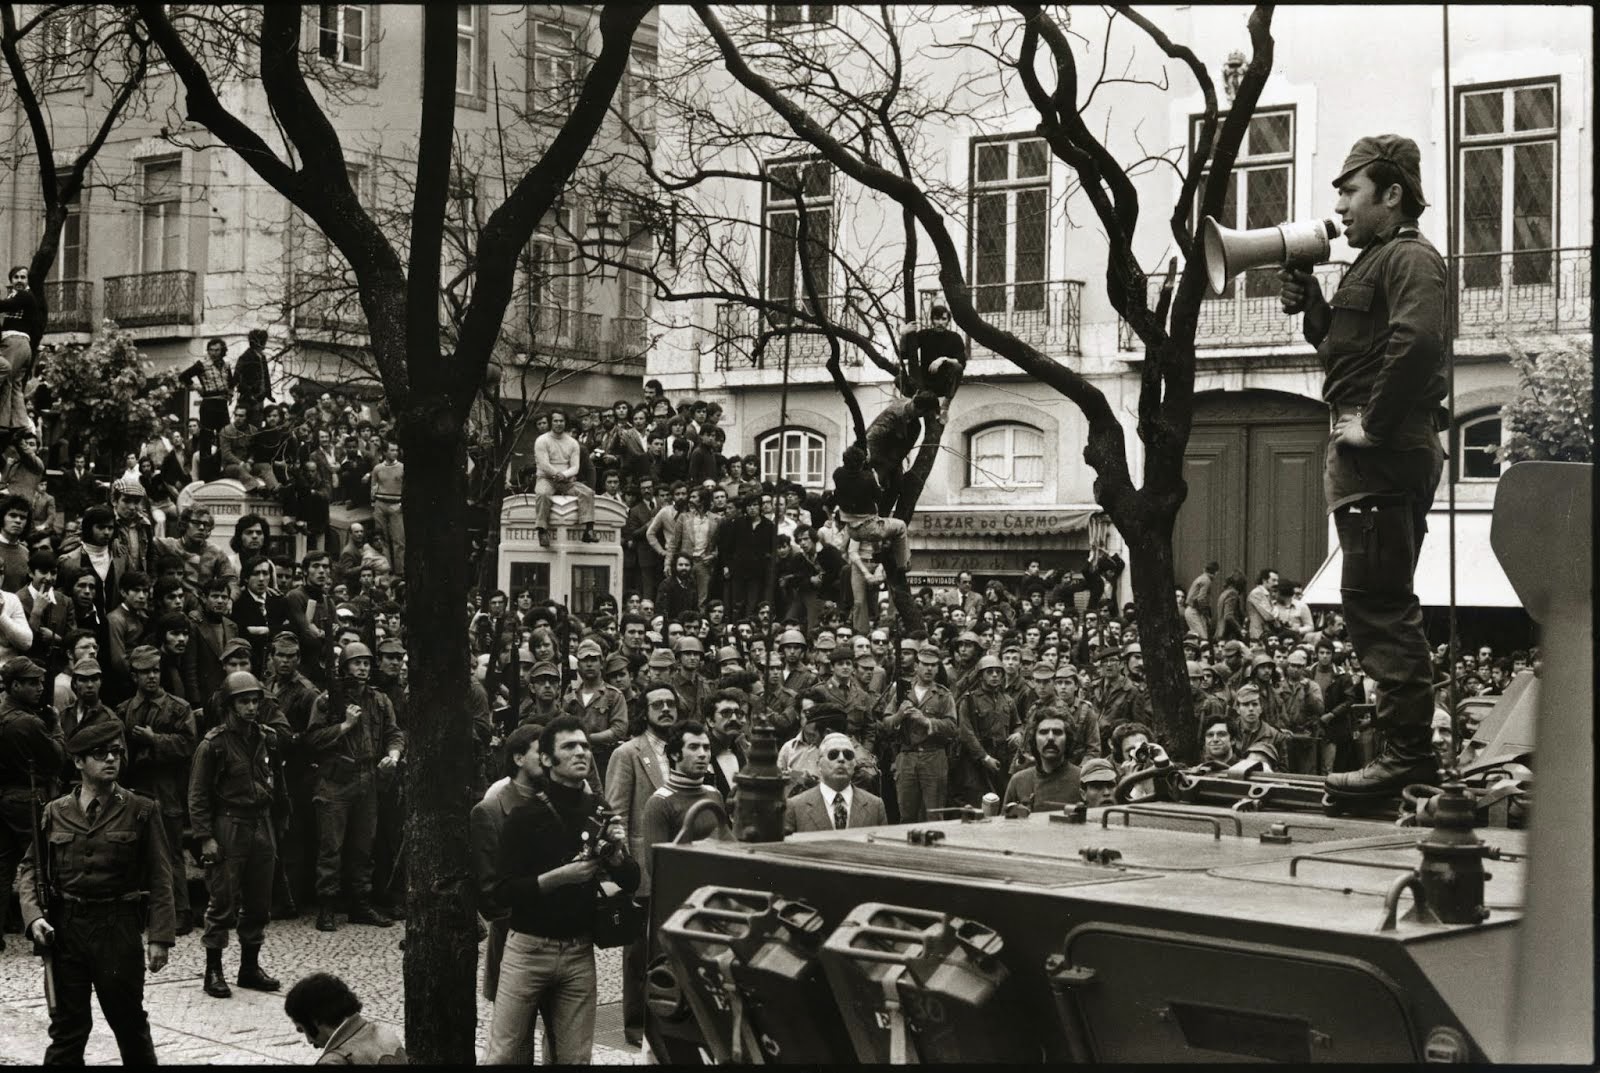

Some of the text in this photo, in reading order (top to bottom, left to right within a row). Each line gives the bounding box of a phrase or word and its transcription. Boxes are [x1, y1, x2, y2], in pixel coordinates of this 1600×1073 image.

[923, 515, 973, 529] BAZAR
[1004, 514, 1058, 528] CARMO
[566, 529, 615, 542] TELONE
